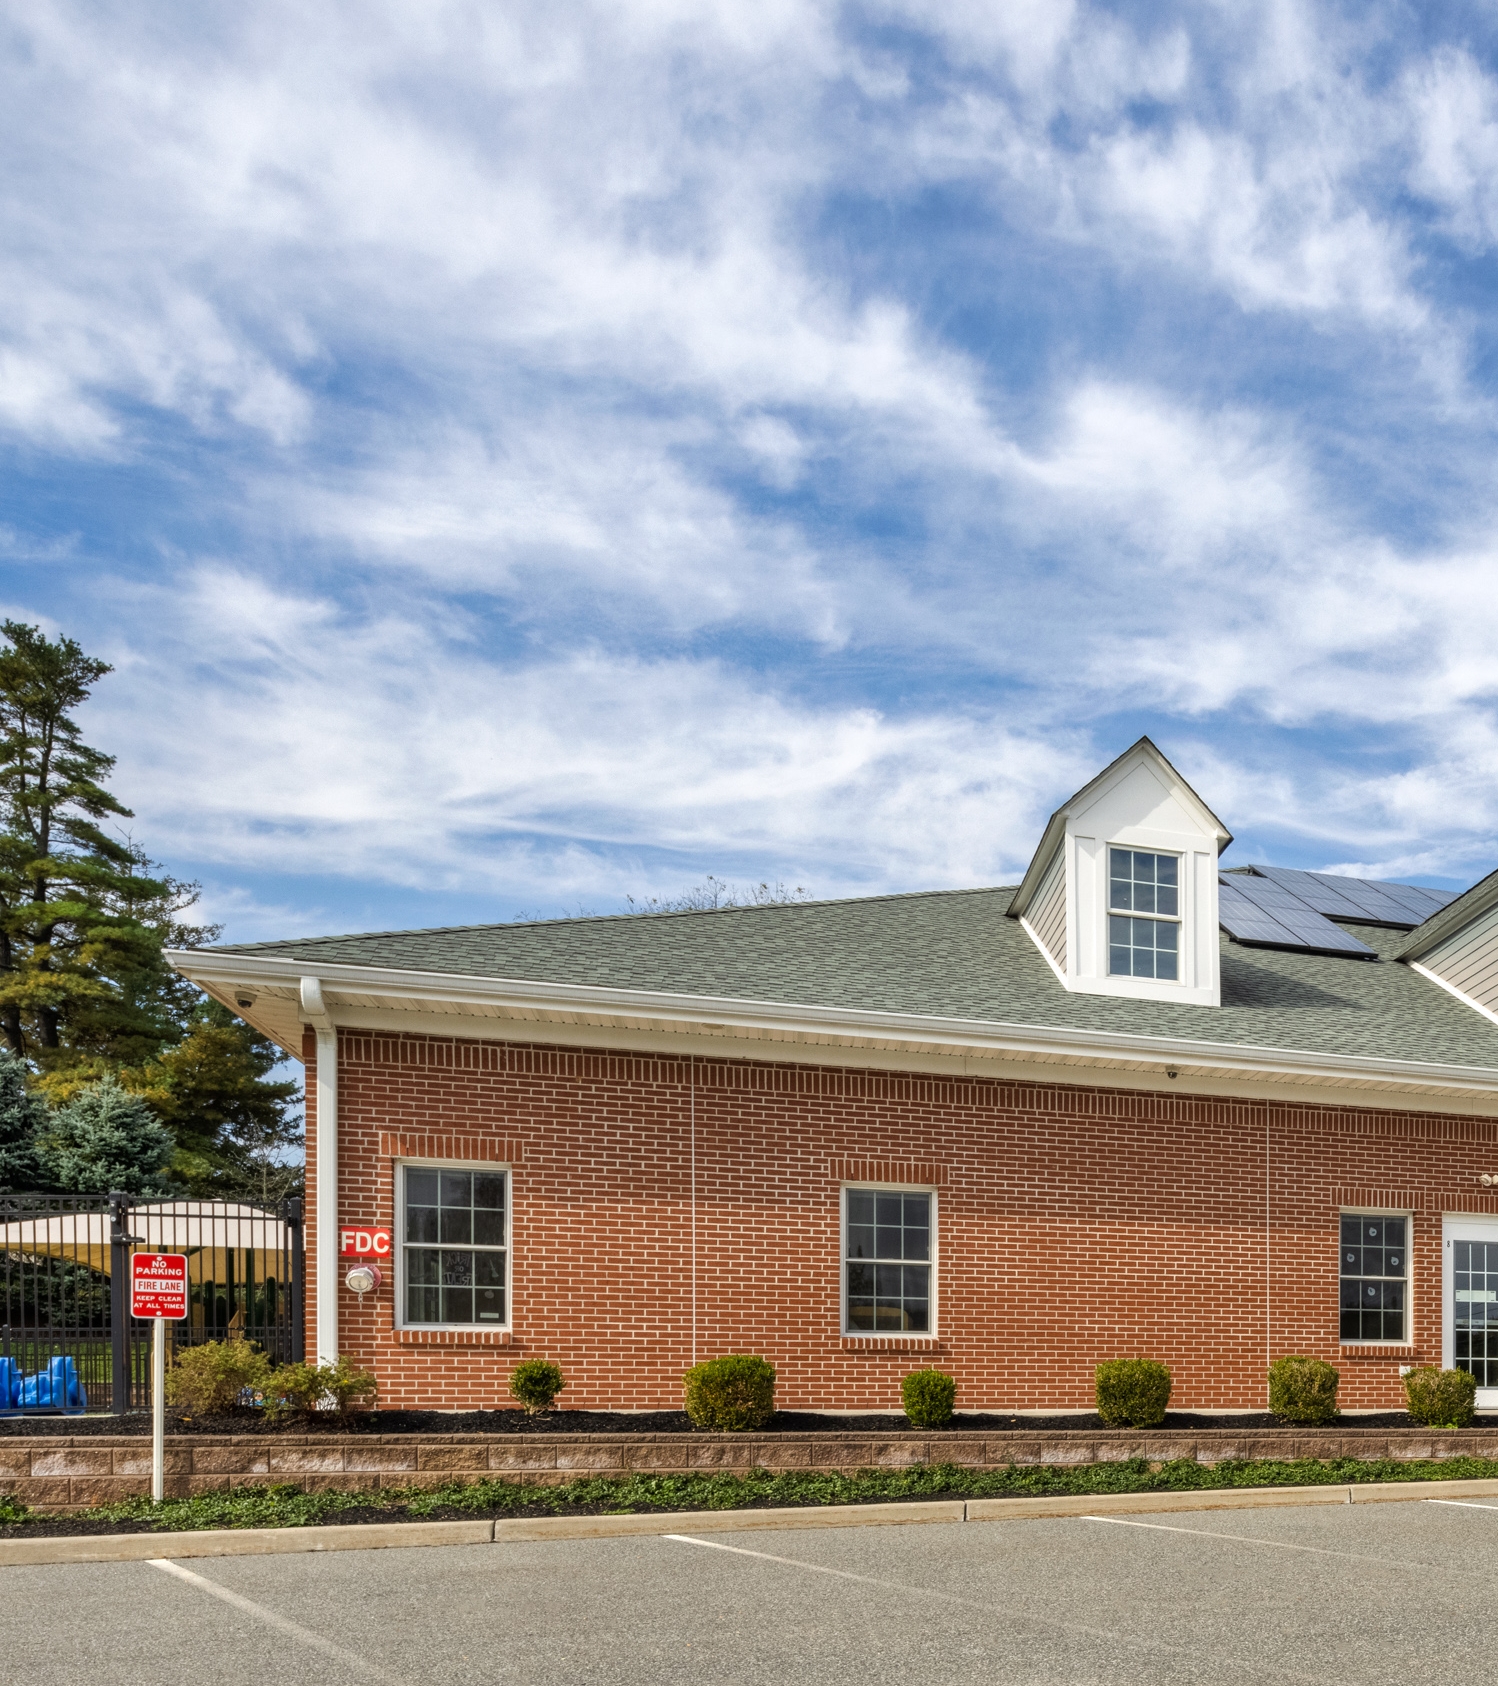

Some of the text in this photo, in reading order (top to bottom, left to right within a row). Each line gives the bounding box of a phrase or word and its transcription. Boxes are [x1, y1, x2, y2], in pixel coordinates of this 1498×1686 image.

[341, 1231, 390, 1254] FDC
[151, 1260, 167, 1268] NO
[135, 1267, 183, 1276] PARKING
[137, 1281, 182, 1291] FIRE LANE
